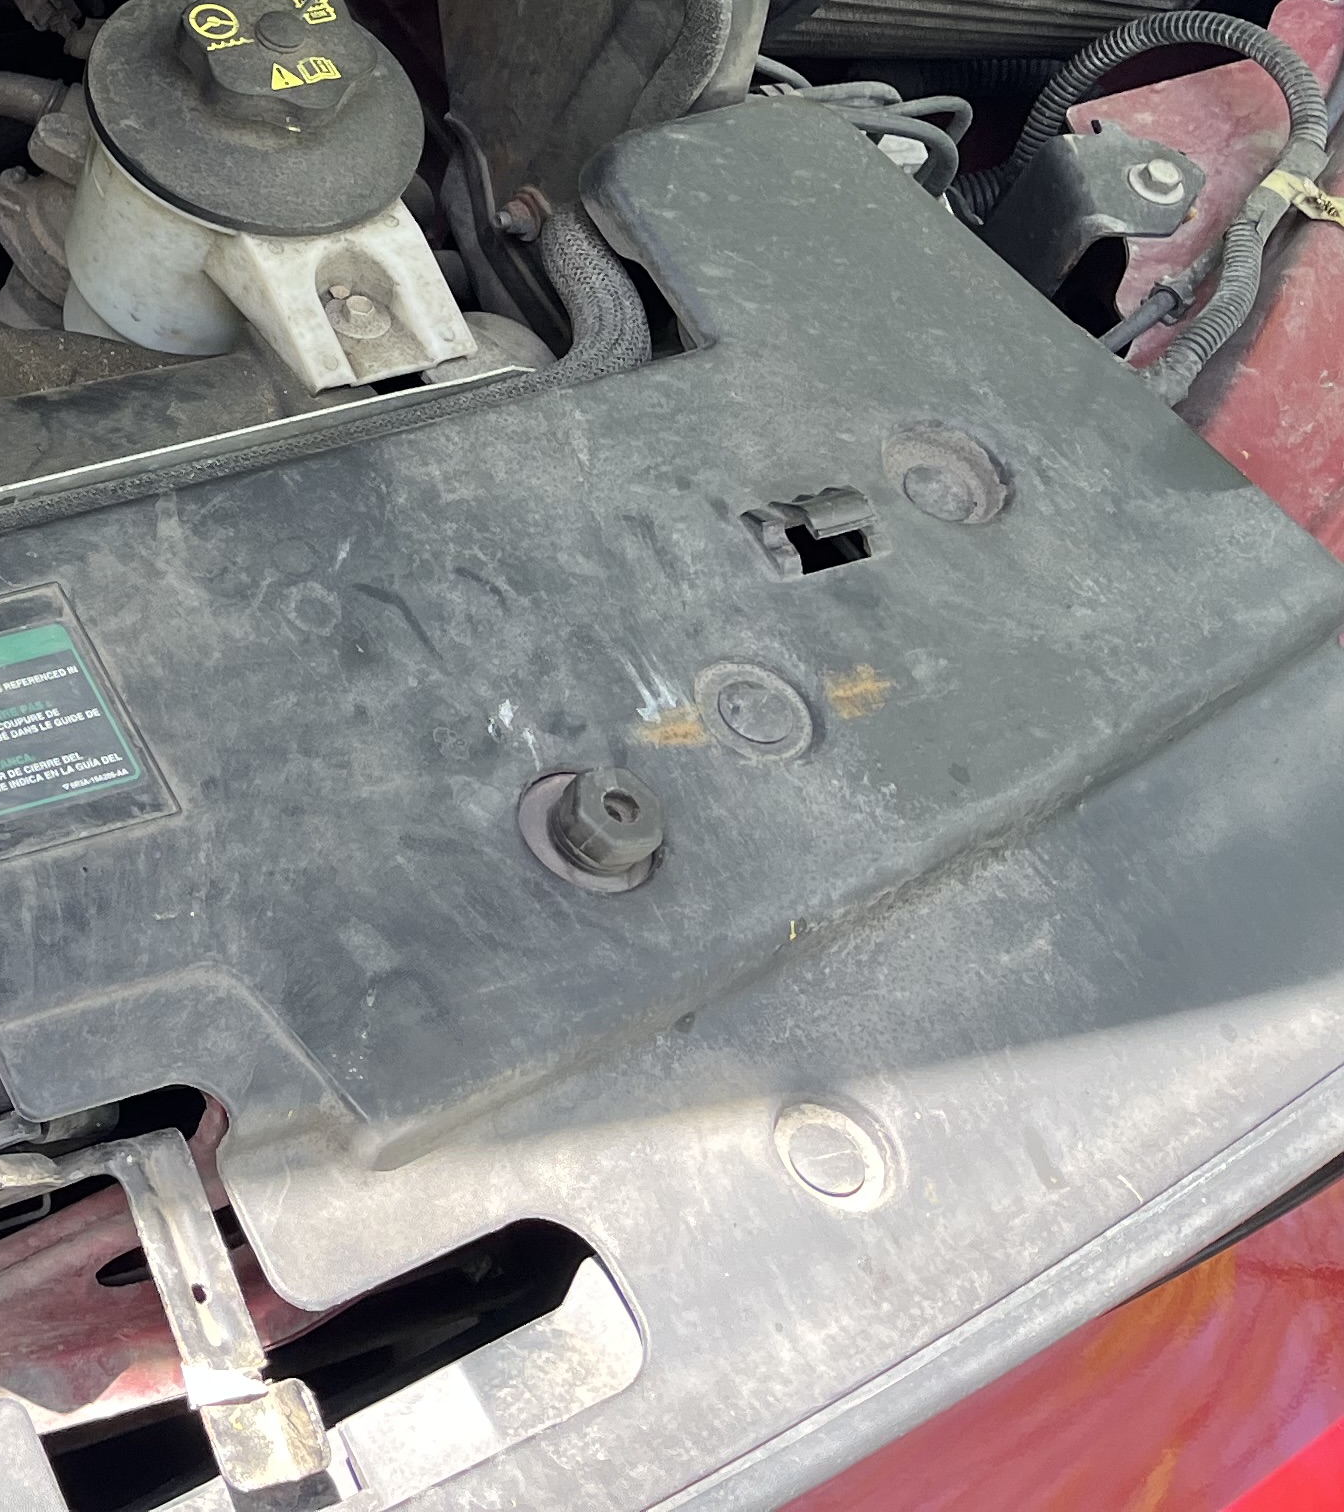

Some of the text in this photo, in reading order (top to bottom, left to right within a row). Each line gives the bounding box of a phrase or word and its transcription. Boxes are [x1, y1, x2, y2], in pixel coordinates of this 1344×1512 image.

[2, 666, 67, 691] REFERENCED
[65, 663, 78, 674] IN
[18, 699, 45, 714] PAS
[43, 706, 60, 717] DE
[8, 722, 39, 738] DANS
[37, 719, 53, 730] LE
[51, 710, 85, 727] GUIDE
[83, 706, 100, 718] DE
[6, 766, 23, 778] DE
[21, 755, 62, 774] CIERRE
[60, 749, 84, 763] DEL
[7, 771, 44, 789] INDICA
[42, 767, 60, 780] EN
[58, 763, 75, 775] LA
[99, 750, 123, 764] DEL
